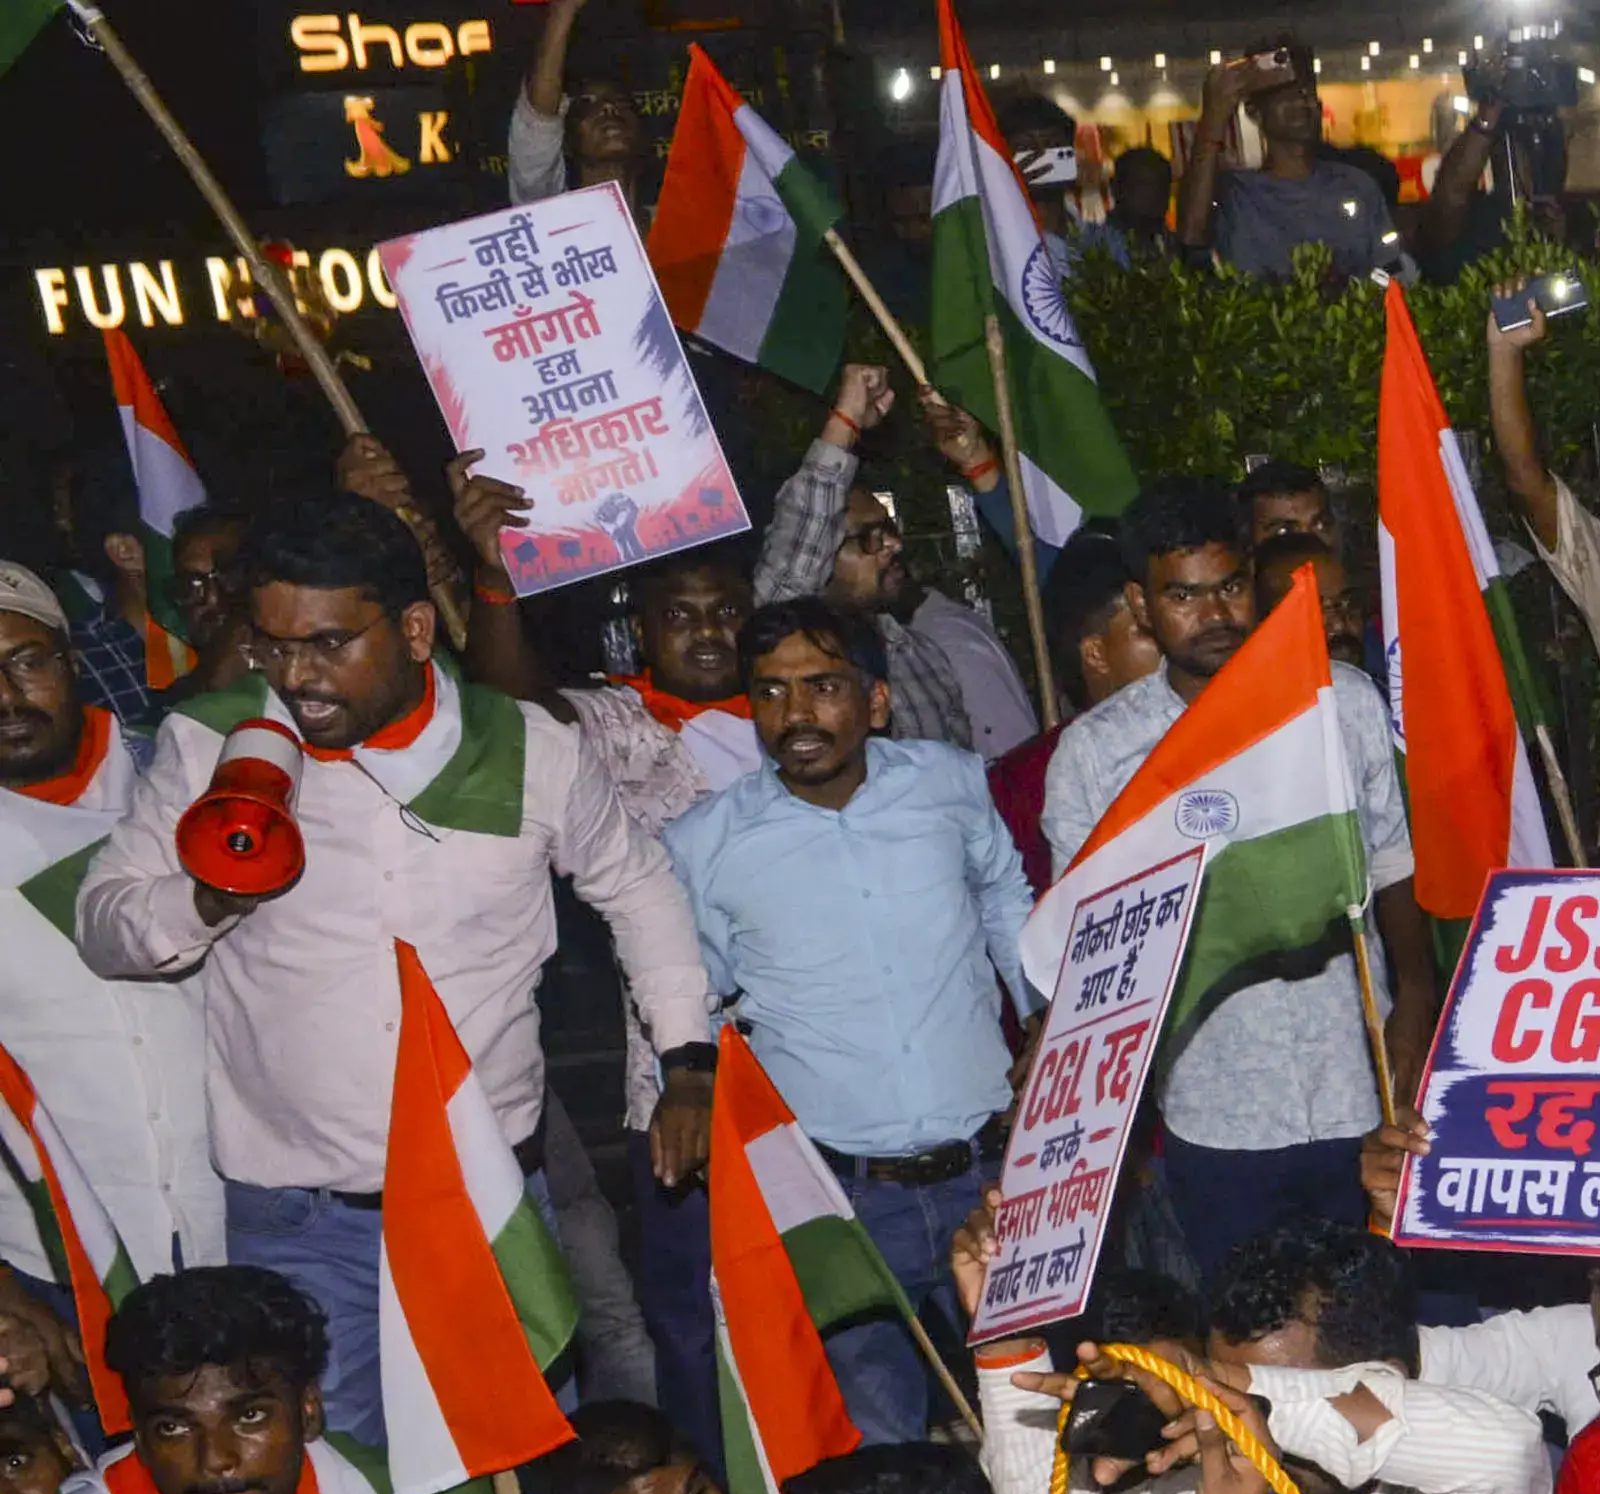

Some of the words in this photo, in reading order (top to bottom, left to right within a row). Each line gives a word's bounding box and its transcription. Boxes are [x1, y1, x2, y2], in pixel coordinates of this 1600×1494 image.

[469, 212, 540, 269] नहीं
[34, 258, 184, 334] FUN
[434, 269, 517, 324] किसी
[516, 258, 550, 301] से
[551, 244, 618, 287] भीख
[533, 348, 582, 385] हम
[521, 370, 619, 426] अपना
[506, 396, 670, 477] अधिकार
[1071, 896, 1124, 967] नौकरी
[1154, 881, 1189, 927] कर
[1074, 962, 1117, 1015] आए
[1022, 1035, 1094, 1133] CGL
[1094, 1018, 1152, 1108] रद्द
[1038, 1119, 1087, 1174] करके
[1435, 1156, 1576, 1217] वापस
[1046, 1226, 1087, 1289] करो
